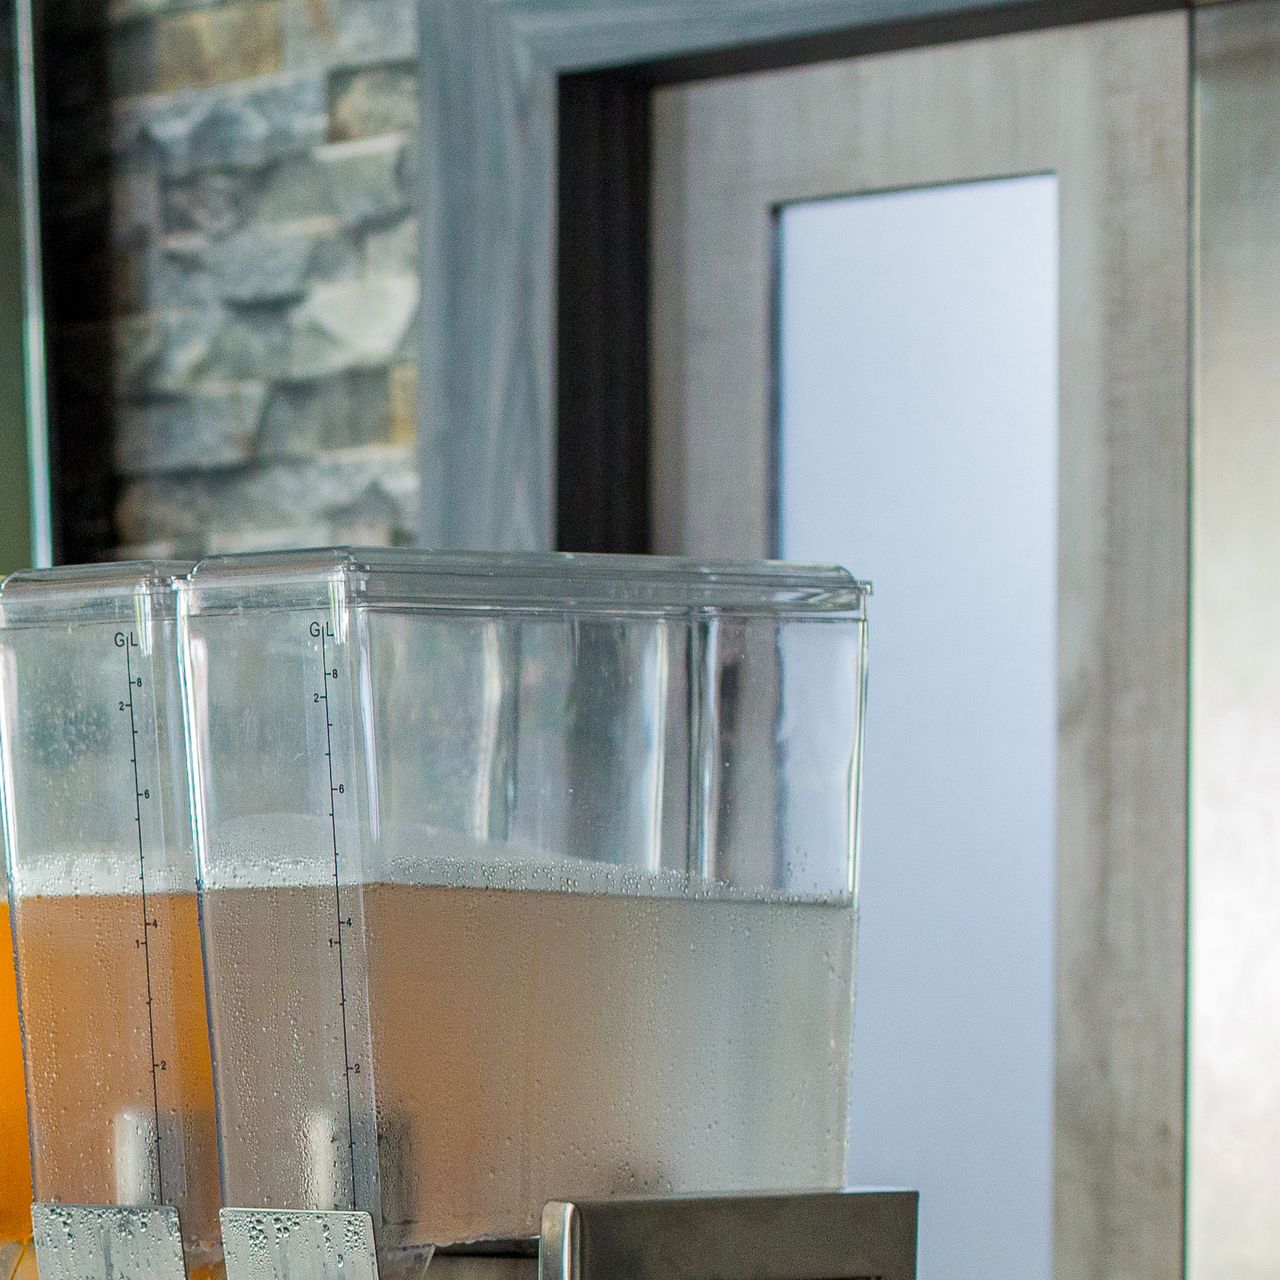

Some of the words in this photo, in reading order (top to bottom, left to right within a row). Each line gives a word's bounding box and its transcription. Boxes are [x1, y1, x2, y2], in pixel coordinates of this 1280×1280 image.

[332, 668, 338, 678] 8
[136, 677, 142, 687] 8
[313, 693, 319, 702] 2
[119, 701, 125, 711] 2
[339, 783, 345, 793] 6
[144, 789, 150, 799] 6
[152, 919, 158, 928] 4
[346, 917, 352, 927] 4
[160, 1060, 167, 1070] 2
[354, 1063, 360, 1073] 2
